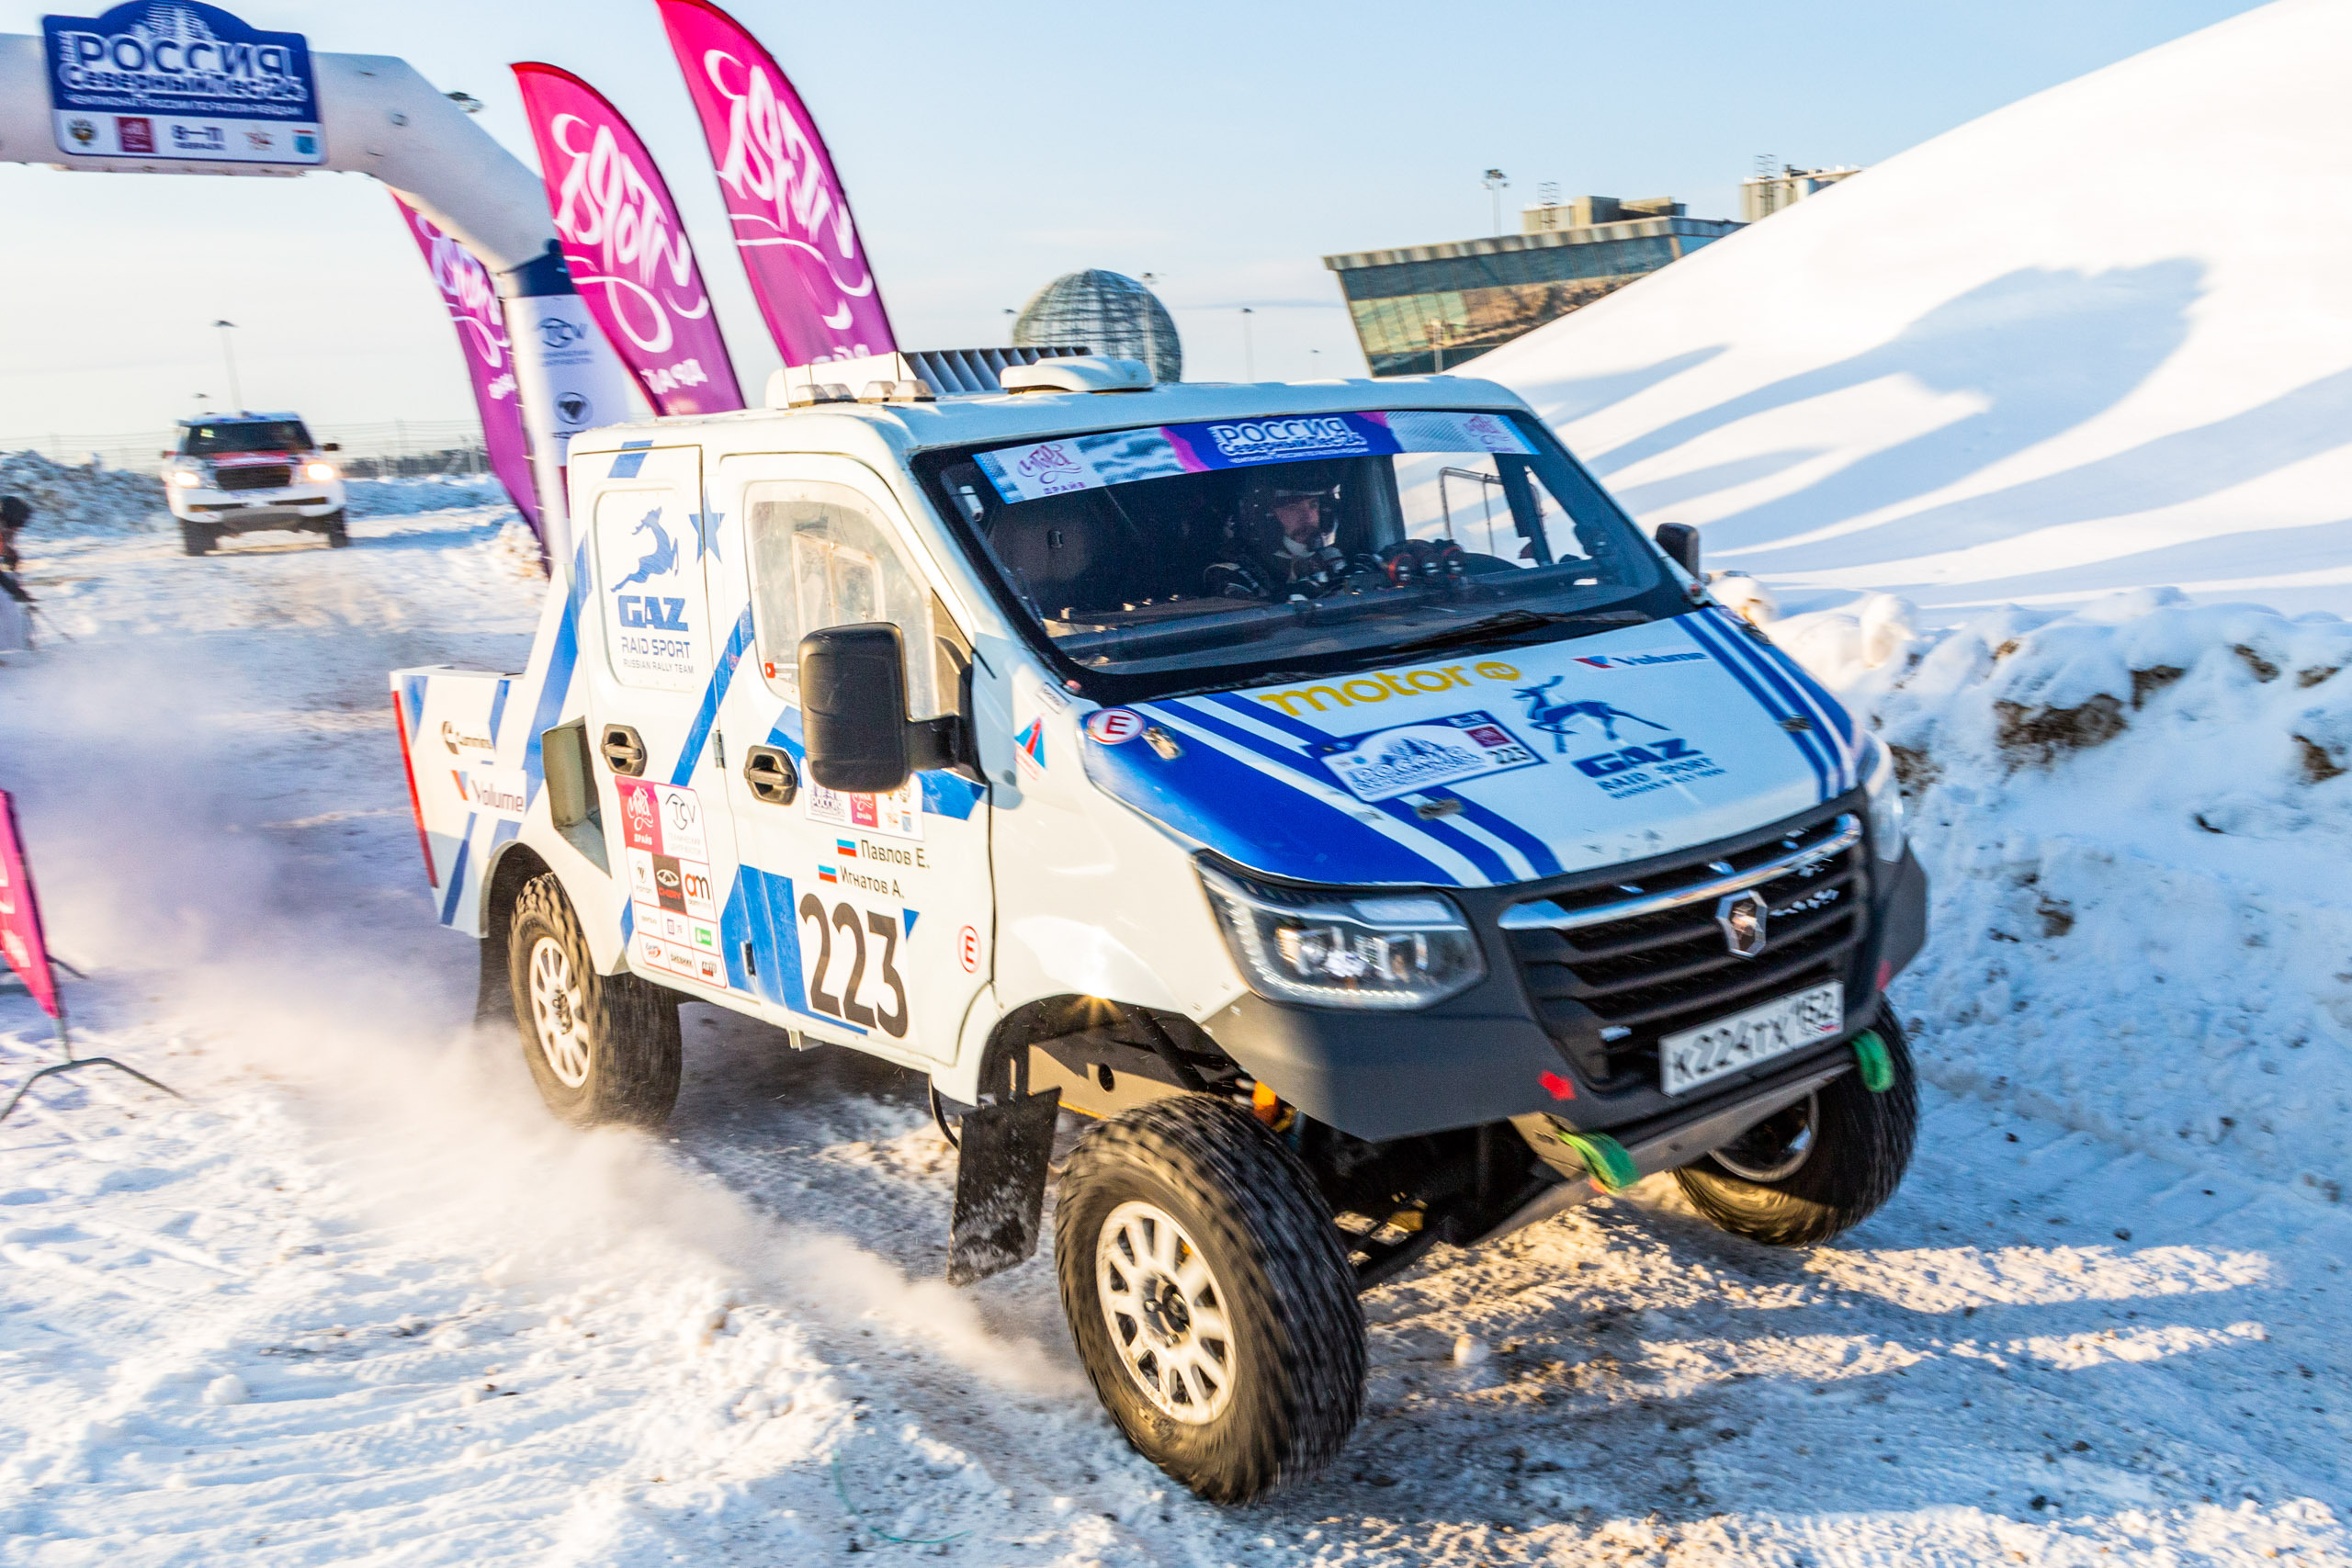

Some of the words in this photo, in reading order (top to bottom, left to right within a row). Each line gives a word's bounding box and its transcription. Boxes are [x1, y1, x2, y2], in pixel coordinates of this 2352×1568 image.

[74, 31, 294, 79] РОССИЯ
[1211, 417, 1352, 445] РОССИЯ
[618, 595, 688, 632] GAZ
[622, 637, 650, 655] RAID
[651, 638, 691, 659] SPORT
[652, 660, 673, 672] RALLY
[674, 662, 695, 673] TEAM
[1259, 663, 1470, 716] motor
[1105, 716, 1132, 735] E
[1485, 746, 1532, 764] 223
[1572, 738, 1703, 777] GAZ
[861, 839, 911, 866] Павлов
[916, 847, 931, 870] Е.
[840, 865, 888, 895] Игнатов
[892, 879, 905, 899] А.
[966, 935, 976, 964] E
[799, 893, 908, 1038] 223
